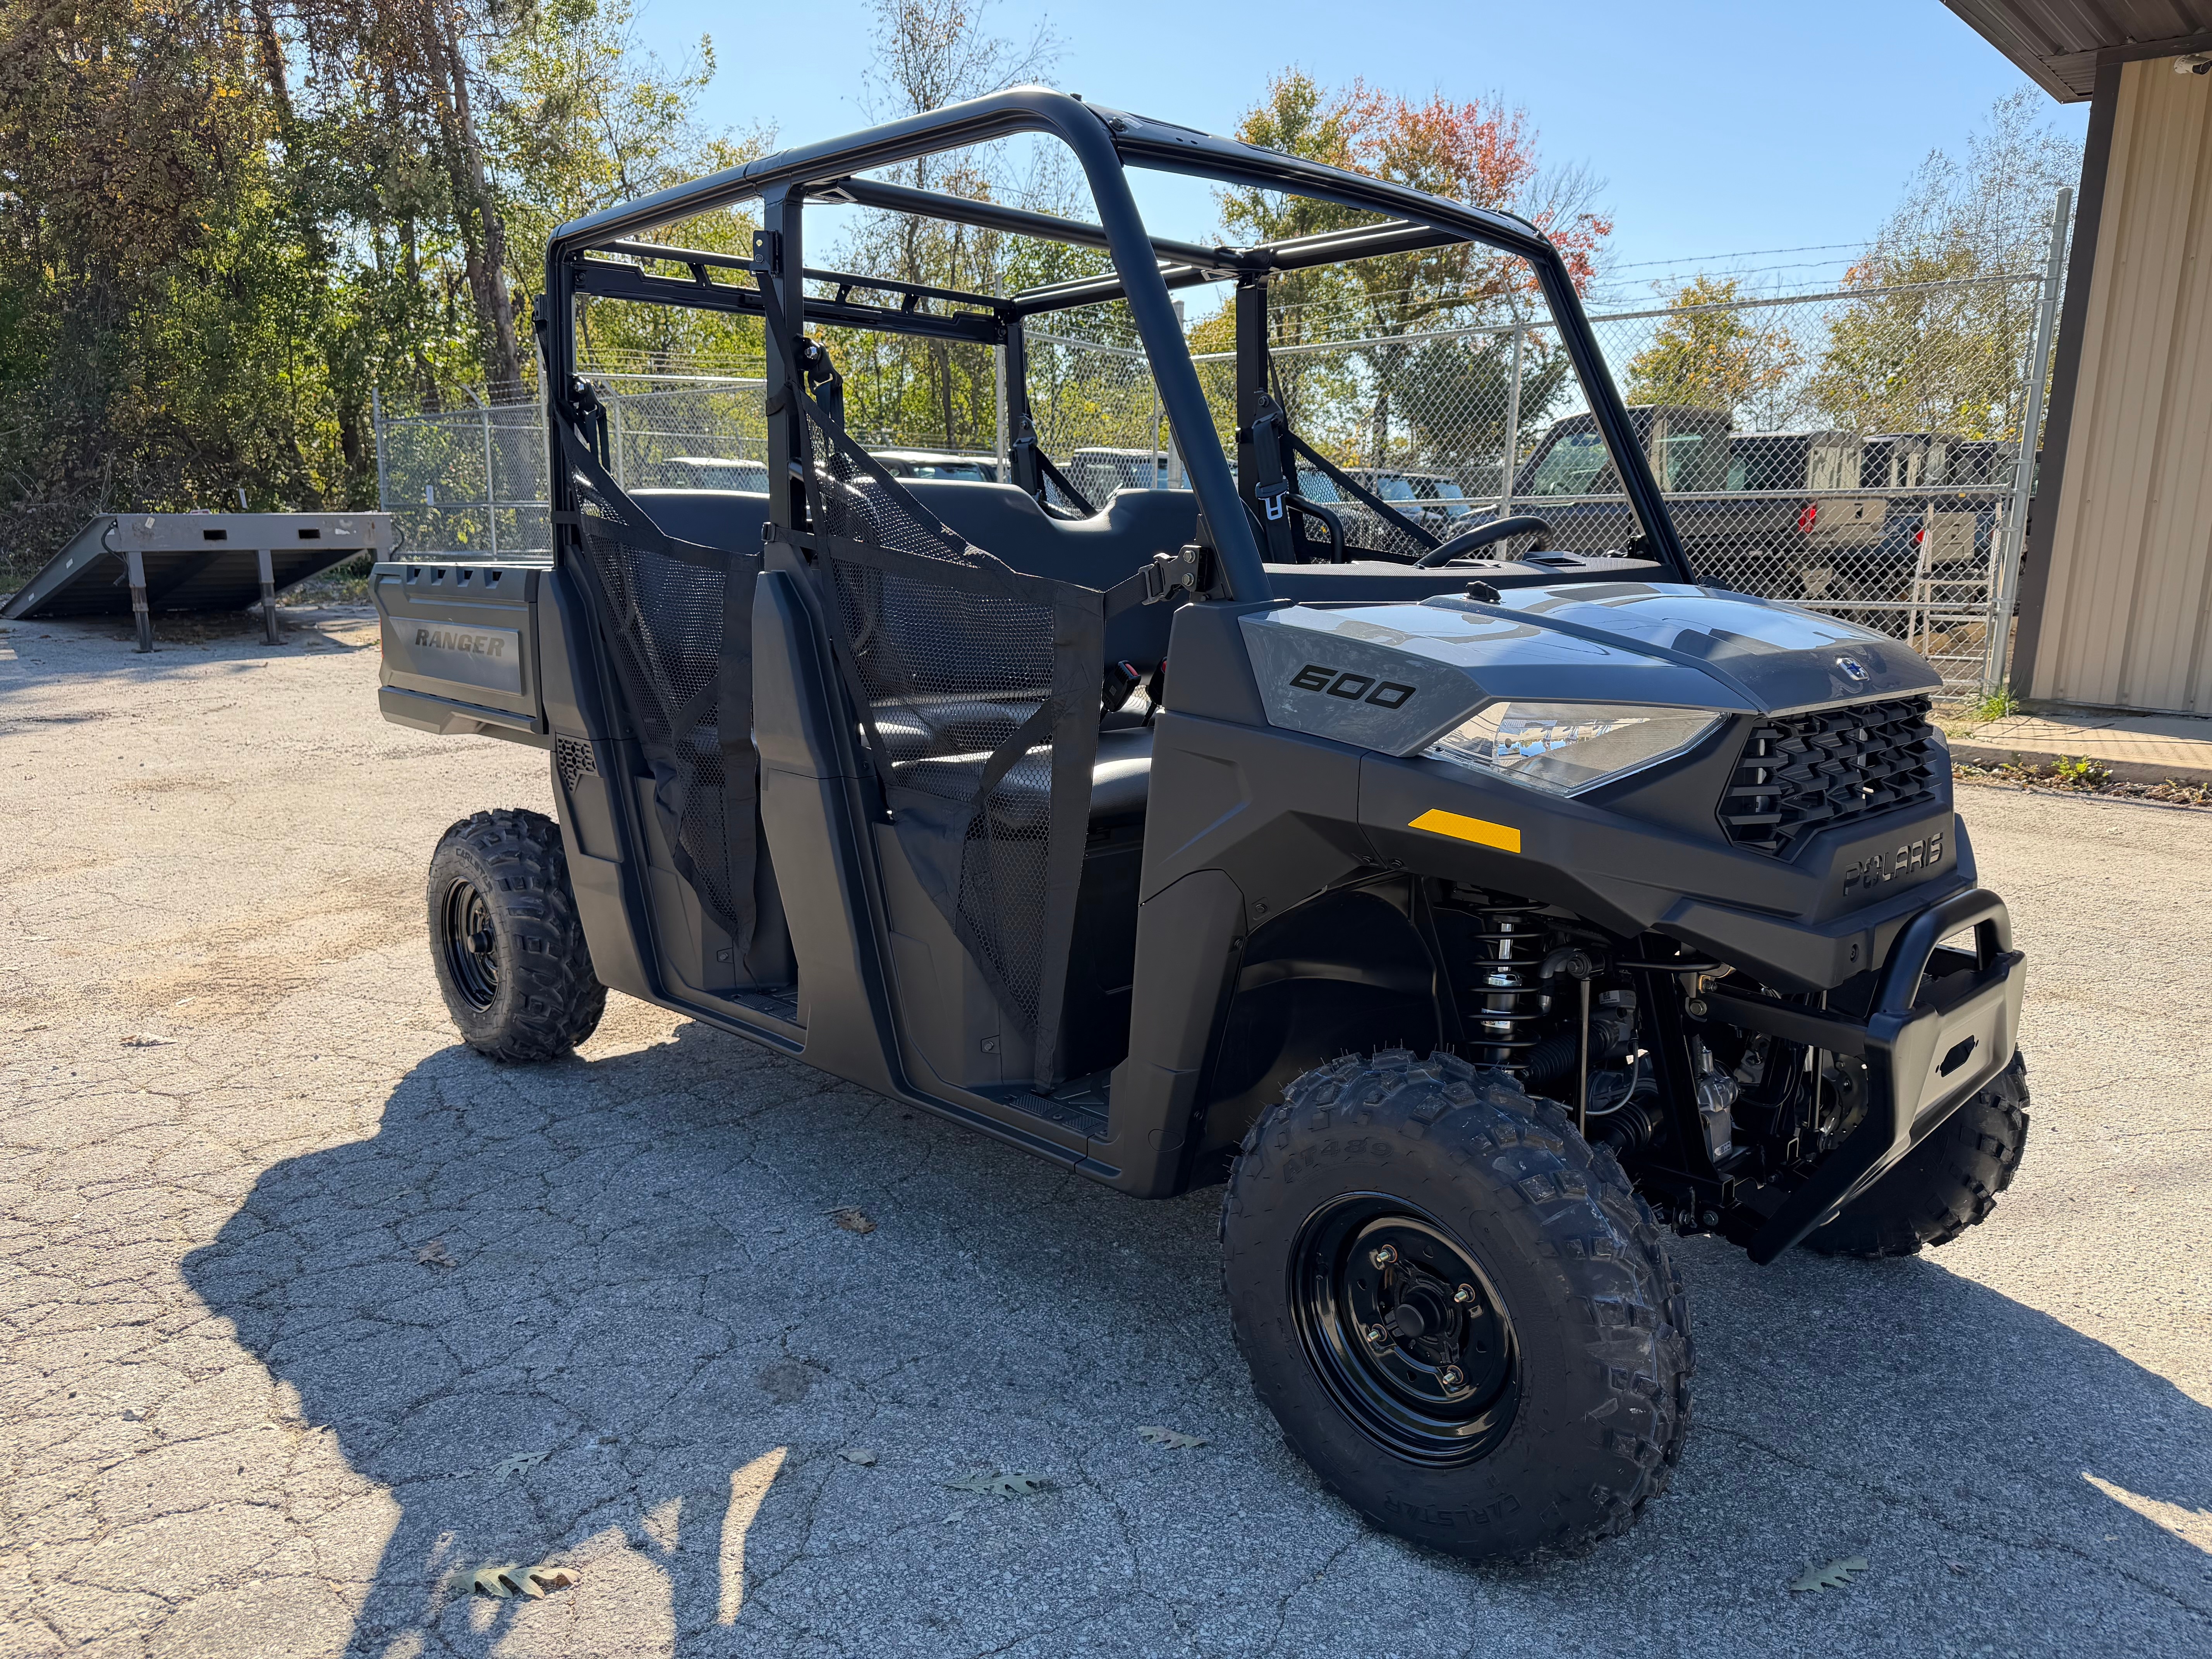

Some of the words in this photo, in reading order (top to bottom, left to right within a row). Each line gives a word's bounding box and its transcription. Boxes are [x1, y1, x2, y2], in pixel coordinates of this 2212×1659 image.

[416, 629, 505, 657] RANGER
[1289, 665, 1416, 709] 600
[1843, 832, 1943, 896] POLARIS
[1283, 1139, 1393, 1183] AT489
[1384, 1494, 1522, 1528] CARLSTAR
